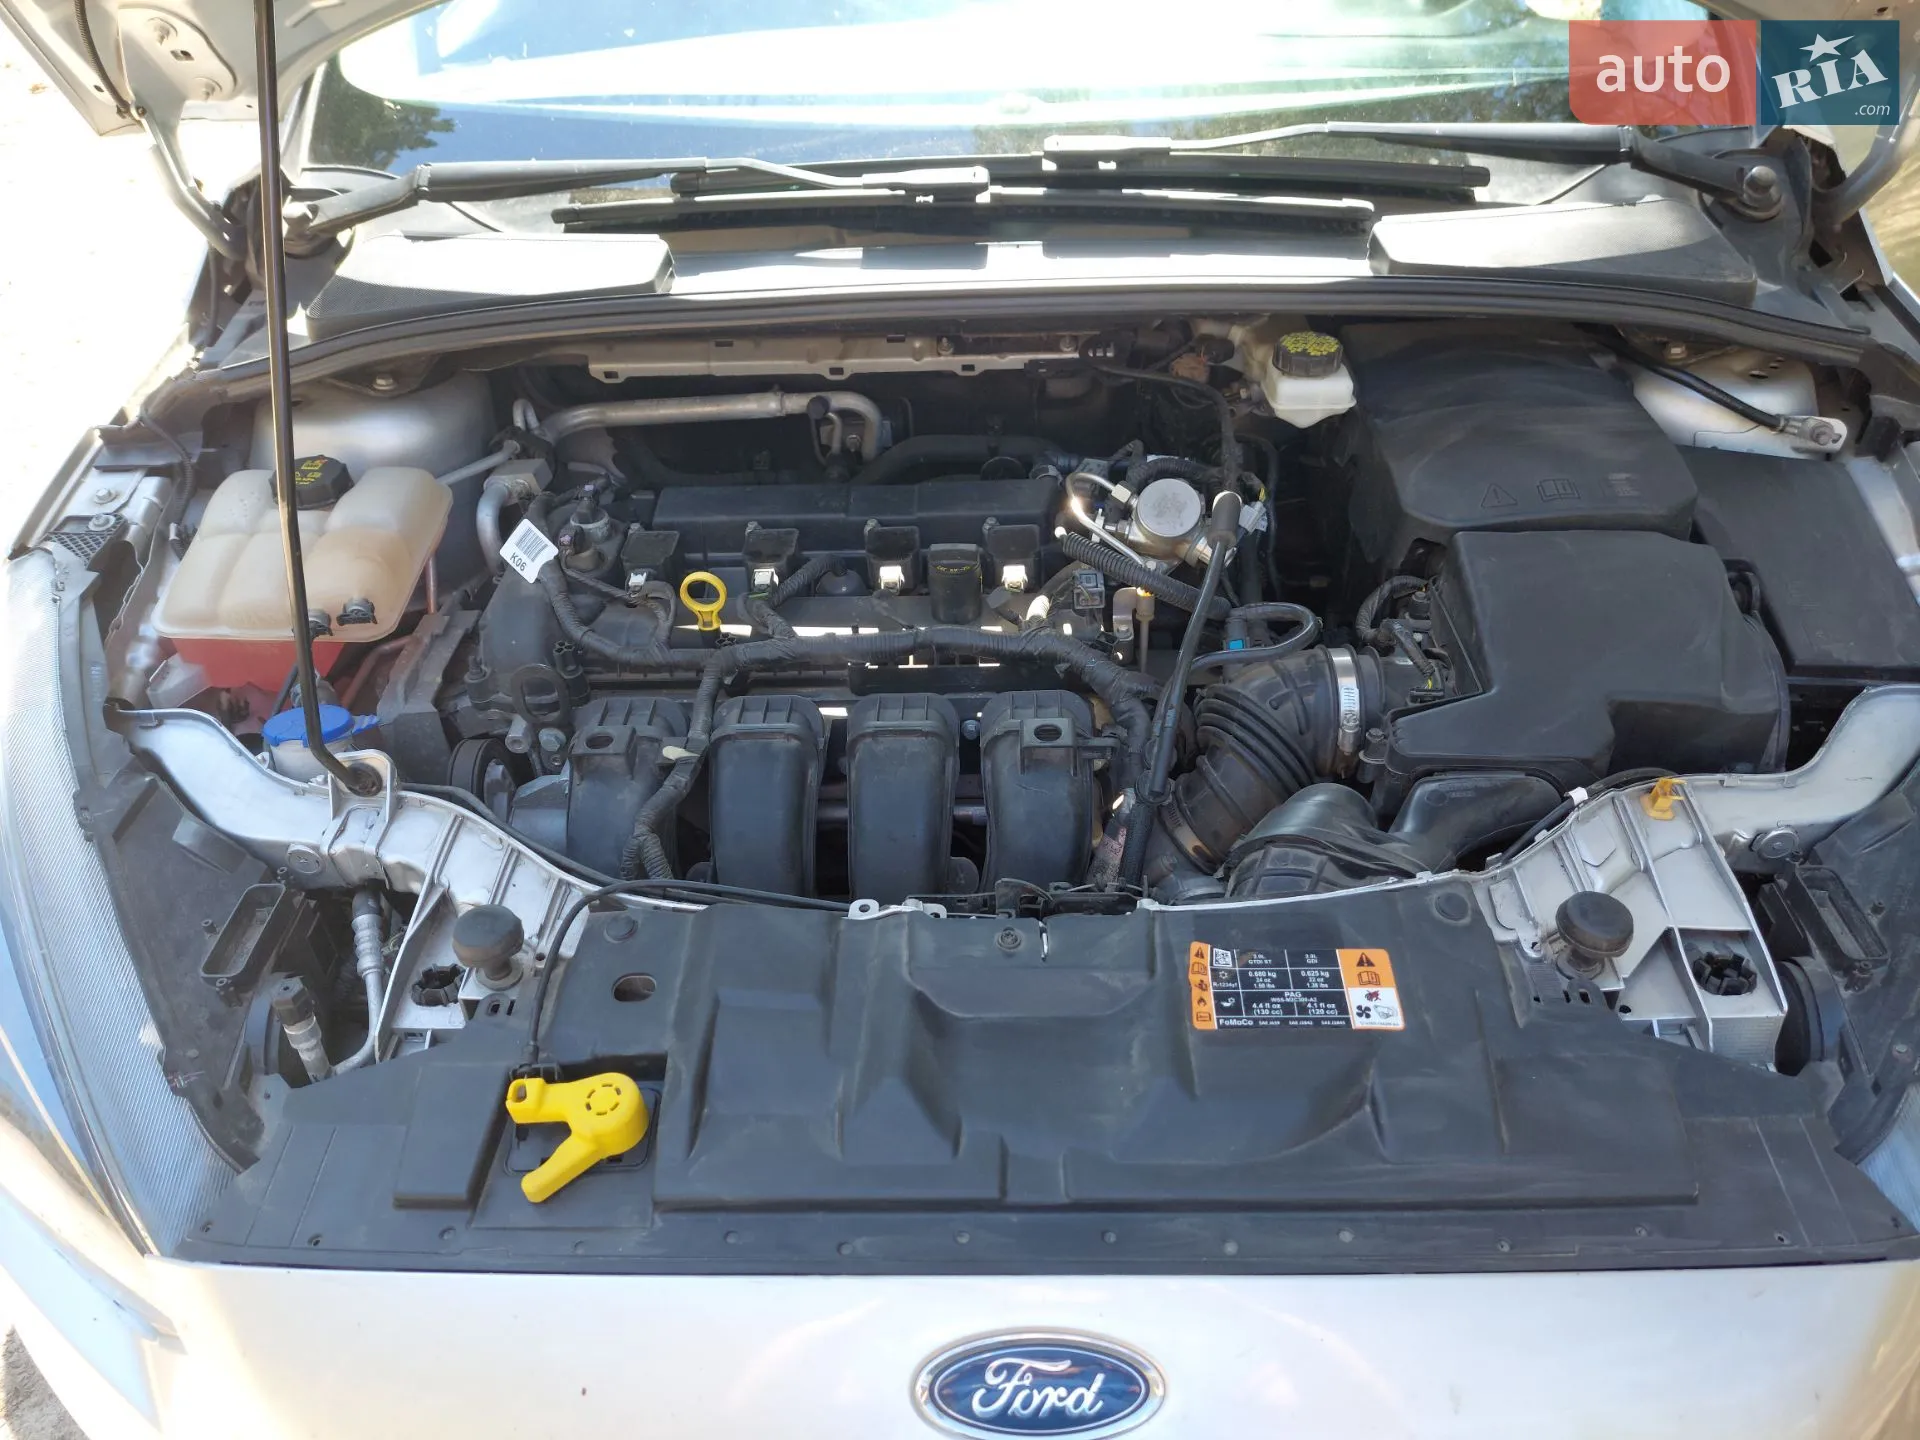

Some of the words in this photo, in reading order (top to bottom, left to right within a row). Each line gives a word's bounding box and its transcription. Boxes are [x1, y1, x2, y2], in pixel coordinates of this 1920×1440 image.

[510, 552, 527, 571] K06
[1219, 1018, 1254, 1026] FoMoCo
[971, 1357, 1106, 1420] Ford
